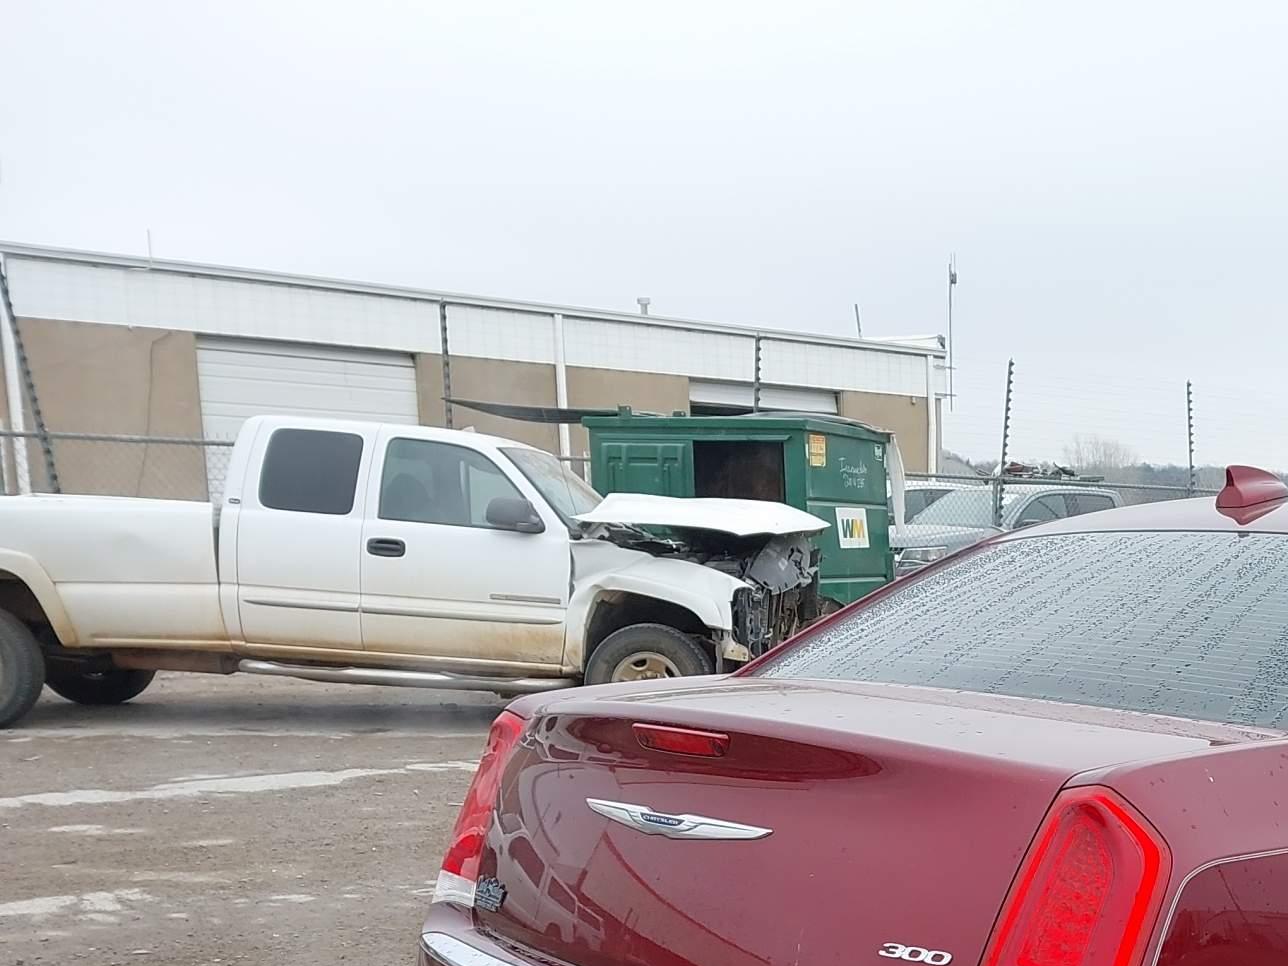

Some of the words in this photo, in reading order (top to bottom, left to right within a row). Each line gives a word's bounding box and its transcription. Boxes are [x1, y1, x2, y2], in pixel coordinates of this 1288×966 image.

[841, 518, 865, 539] WM
[642, 814, 679, 825] CHRYSLER
[878, 942, 953, 966] 300
